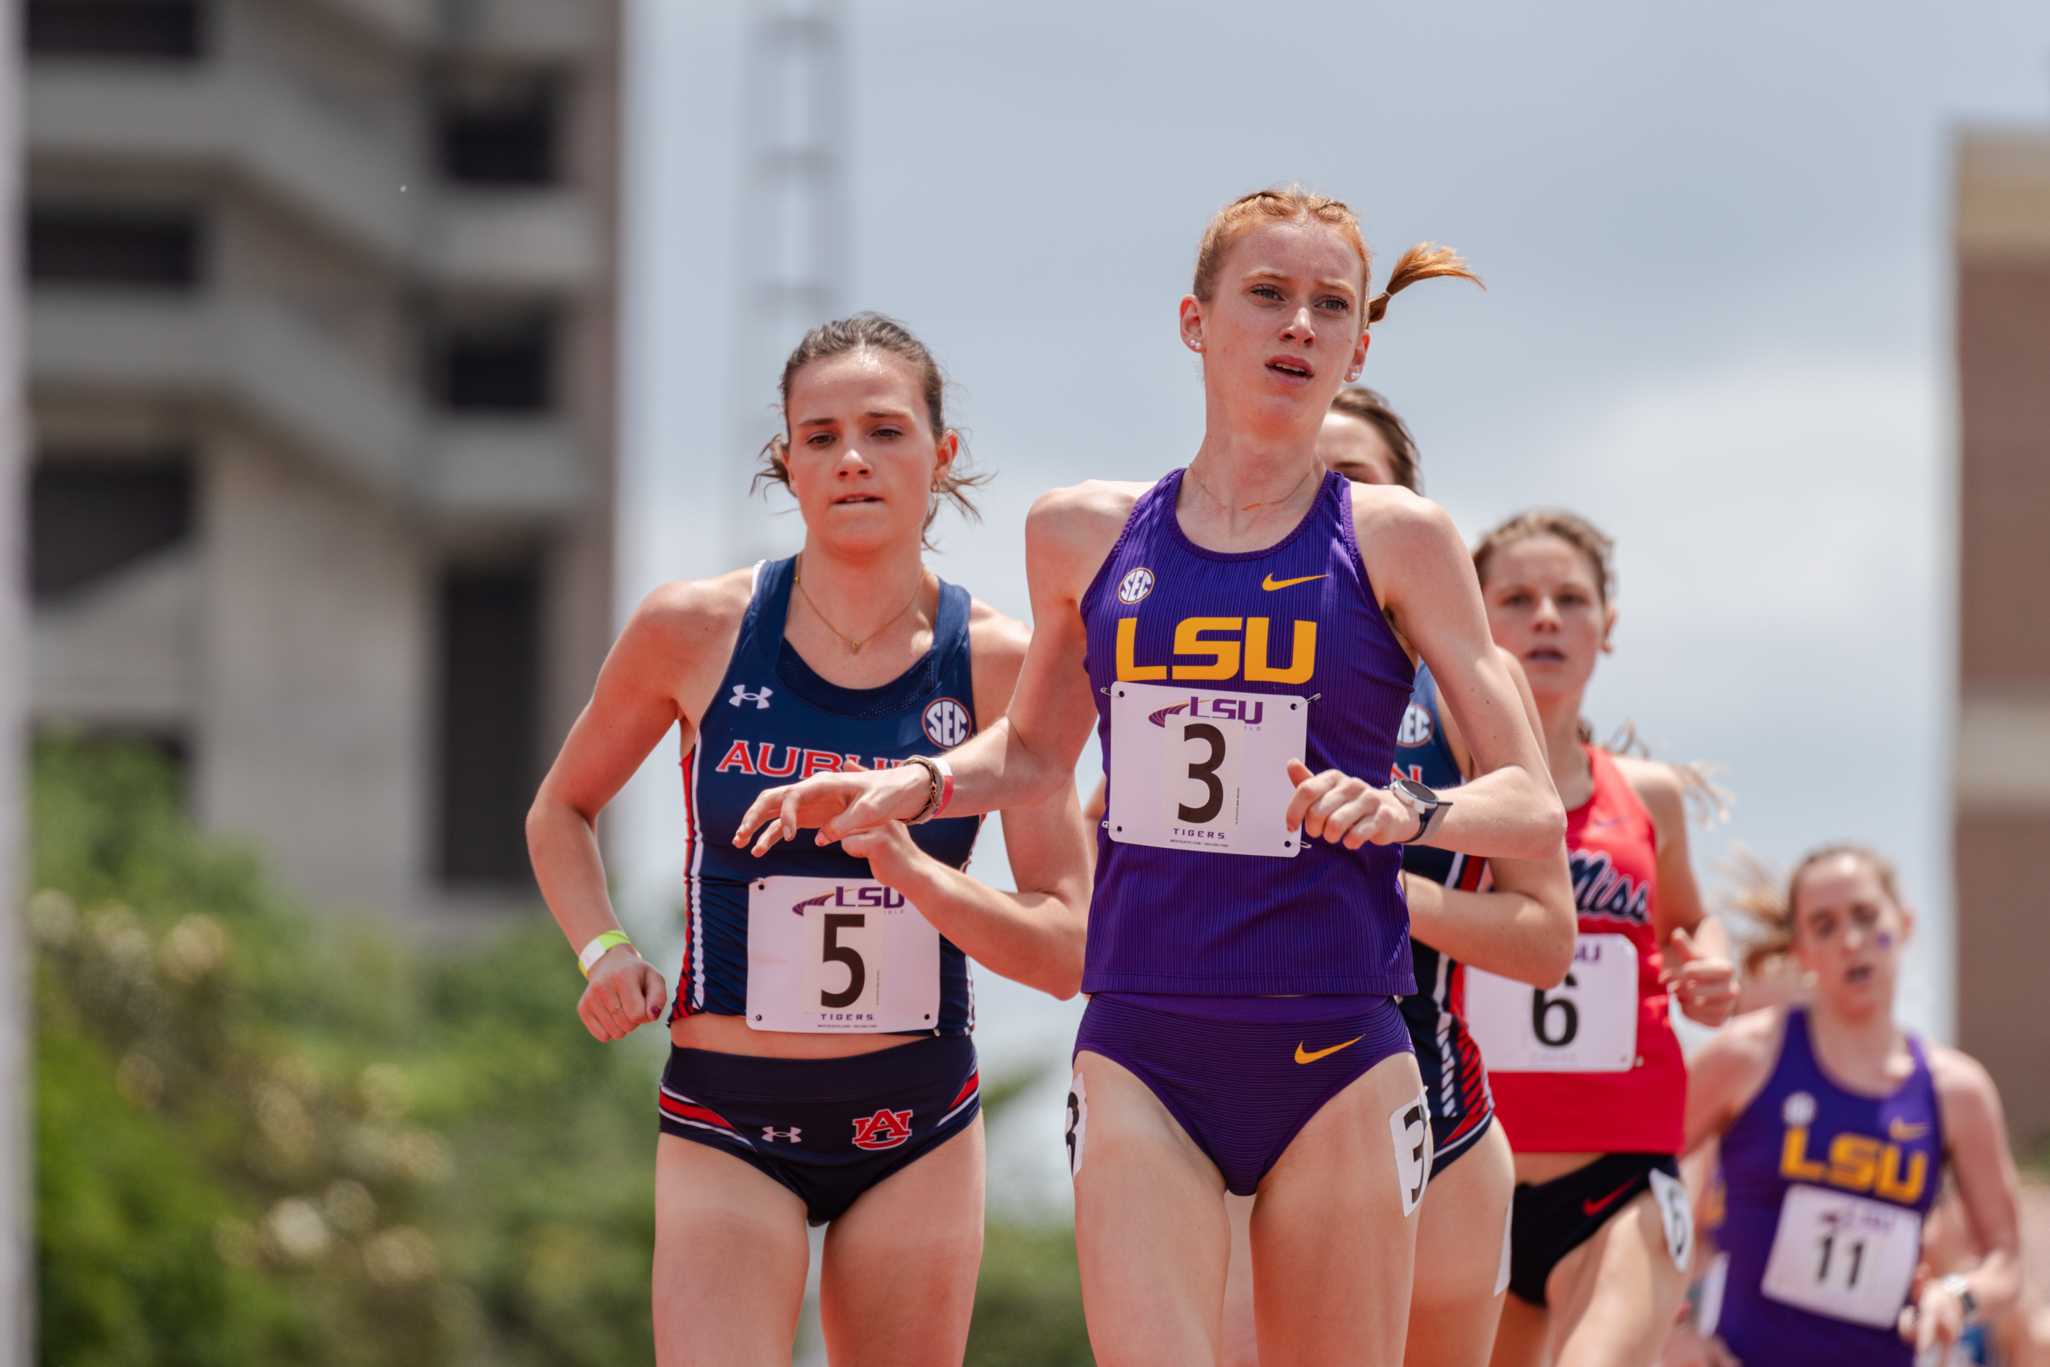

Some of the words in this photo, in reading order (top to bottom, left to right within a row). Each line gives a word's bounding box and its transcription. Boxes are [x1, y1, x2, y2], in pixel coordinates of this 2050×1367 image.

[1120, 570, 1153, 602] SEC
[1116, 617, 1317, 685] LSU
[924, 699, 969, 748] SEC
[1190, 696, 1263, 724] LSU
[1397, 704, 1431, 743] EC
[1177, 723, 1226, 823] 3
[1173, 827, 1225, 839] TIGERS
[835, 886, 905, 909] LSU
[821, 914, 865, 1008] 5
[820, 1013, 873, 1021] TIGERS
[1532, 972, 1578, 1047] 6
[1403, 1103, 1427, 1204] 3
[1780, 1122, 1928, 1204] LSU
[1816, 1236, 1864, 1288] 11
